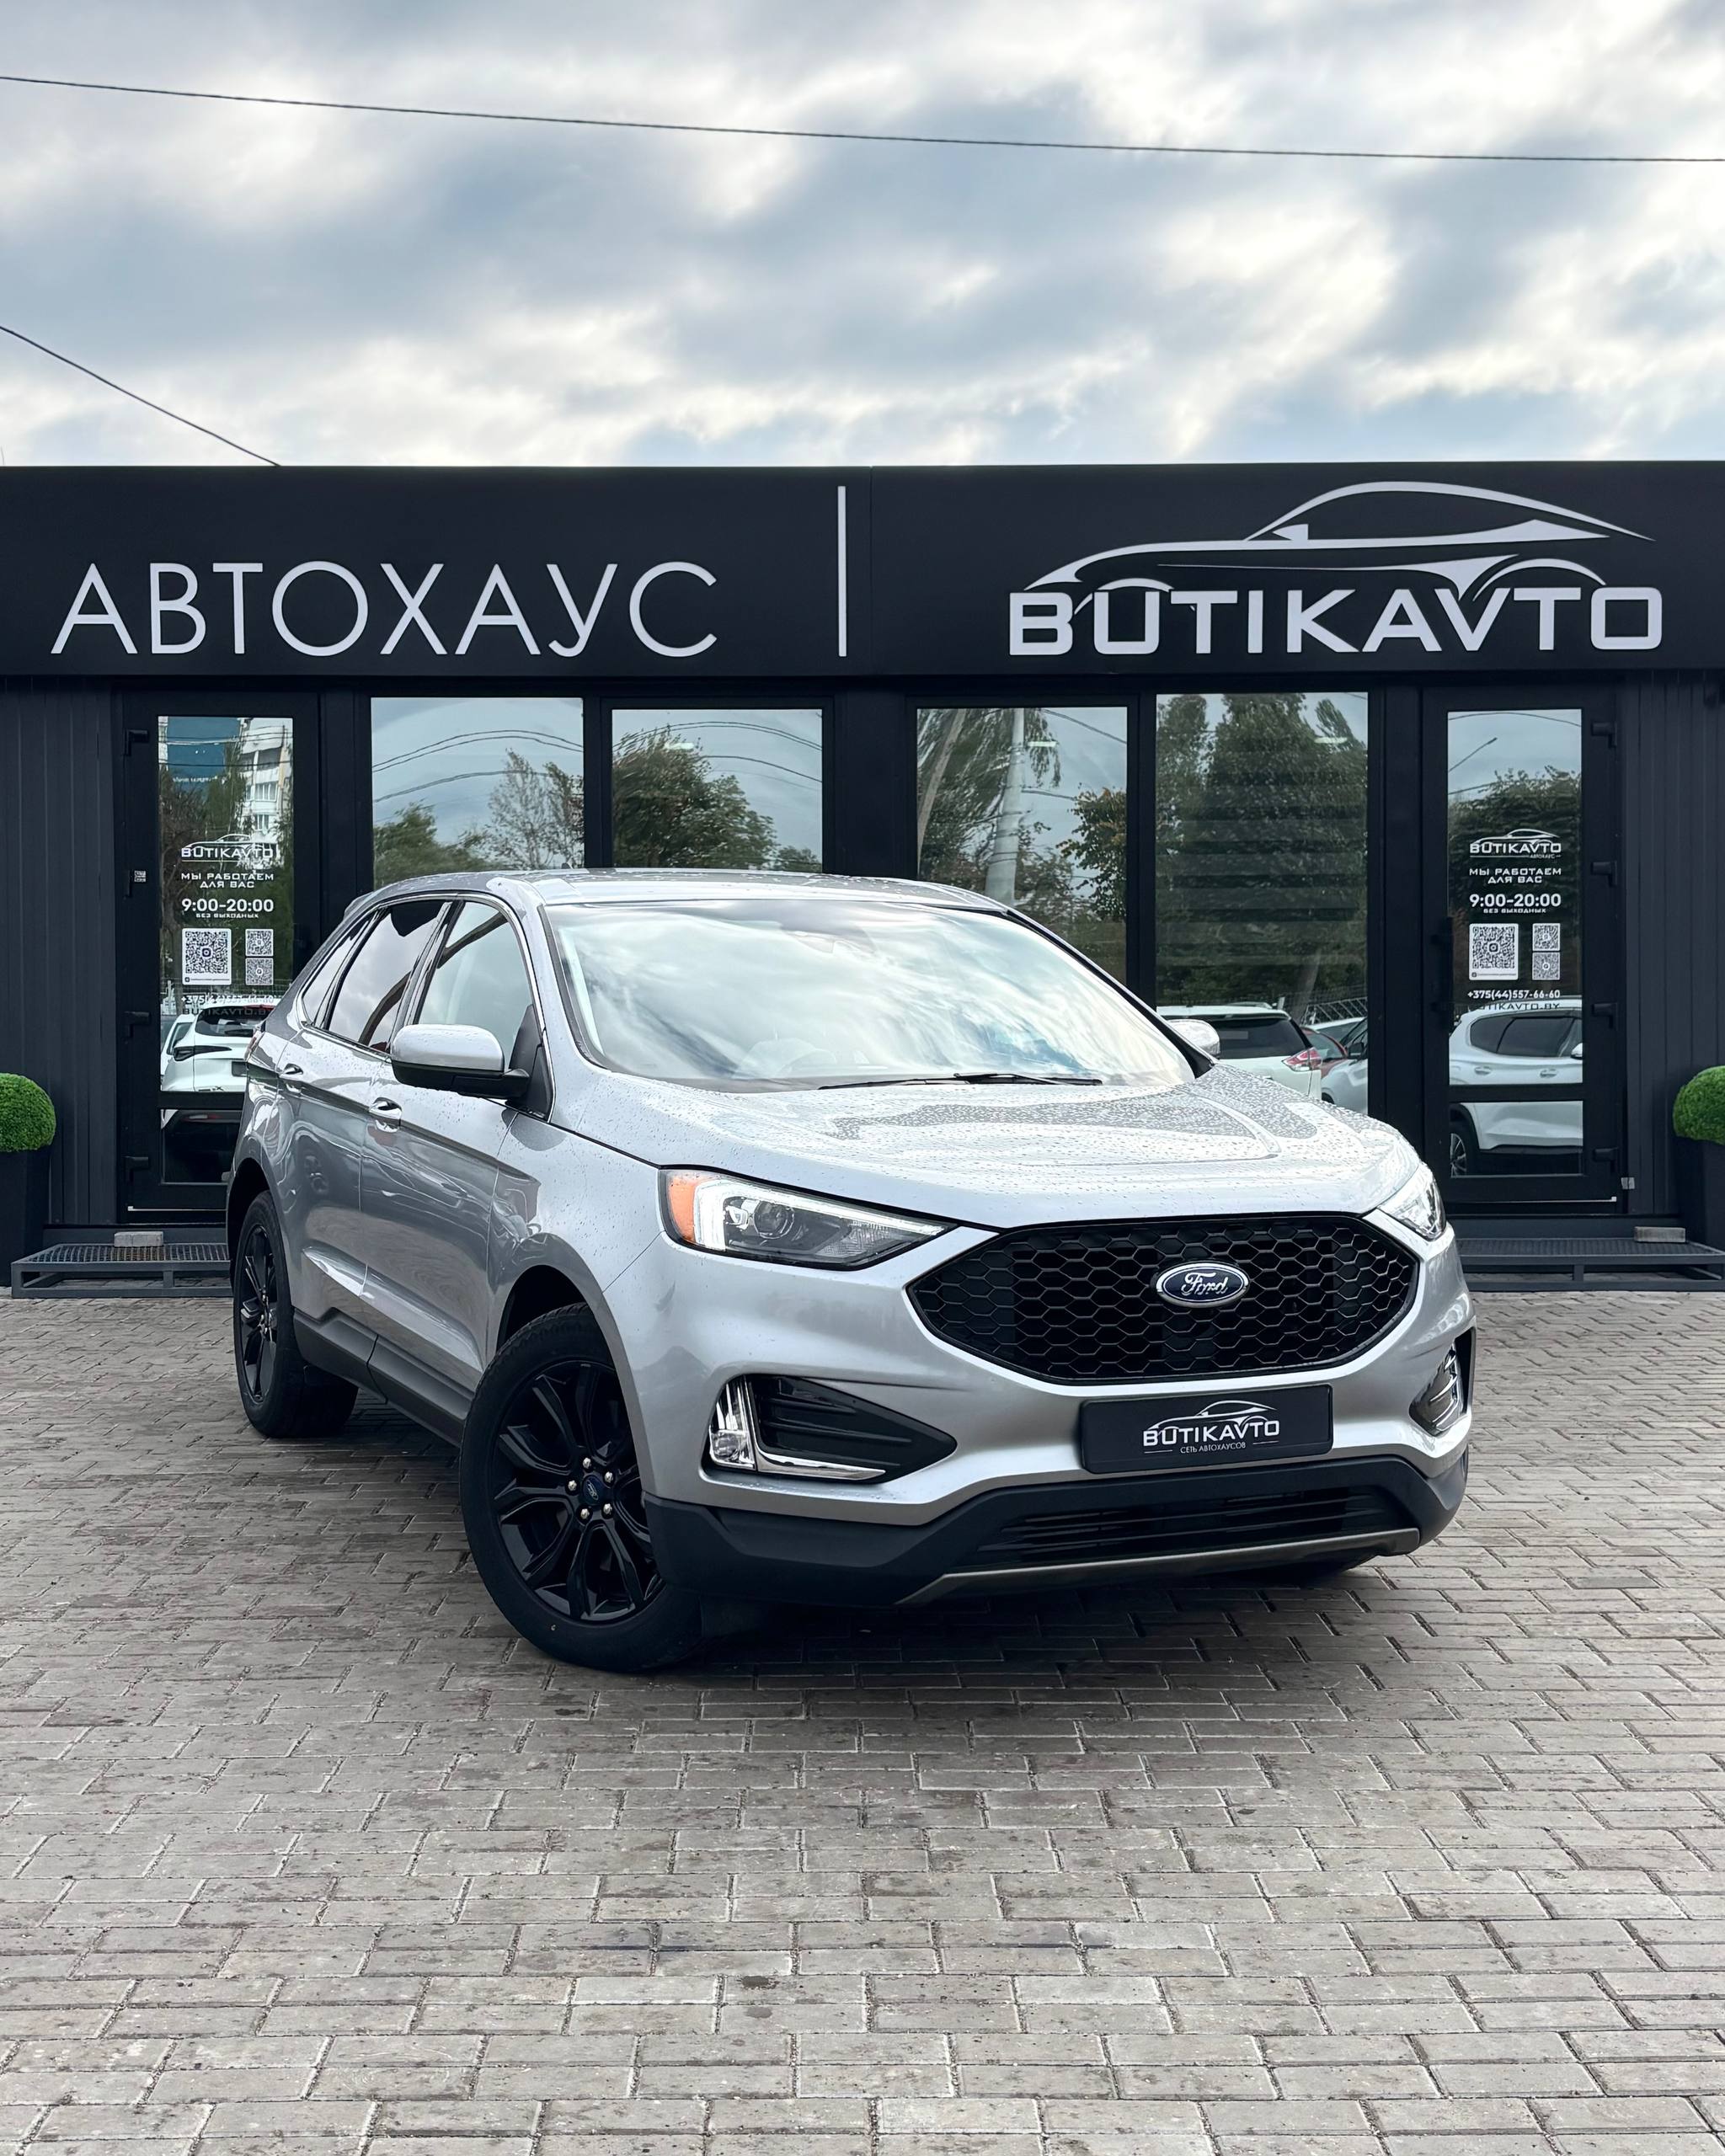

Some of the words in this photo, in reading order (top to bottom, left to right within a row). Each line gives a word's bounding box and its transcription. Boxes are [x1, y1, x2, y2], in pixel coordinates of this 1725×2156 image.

[51, 561, 718, 658] АВТОХАУС
[1009, 587, 1663, 656] BUTIKAVTO
[181, 847, 274, 858] BUTIKAVTO
[1470, 842, 1562, 854] BUTIKAVTO
[181, 873, 201, 881] МЫ
[206, 873, 274, 881] РАБОТАЕМ
[1487, 876, 1513, 884] ДЛЯ
[181, 898, 275, 912] 9:00-20:00
[1469, 893, 1562, 908] 9:00-20:00
[1467, 990, 1561, 1001] +375(44)557-66-60
[1180, 1272, 1229, 1296] Ford
[1143, 1419, 1279, 1447] BUTIKAVTO
[1180, 1445, 1198, 1454] СЕТЬ
[1199, 1442, 1247, 1453] АВТОХАУСОВ
